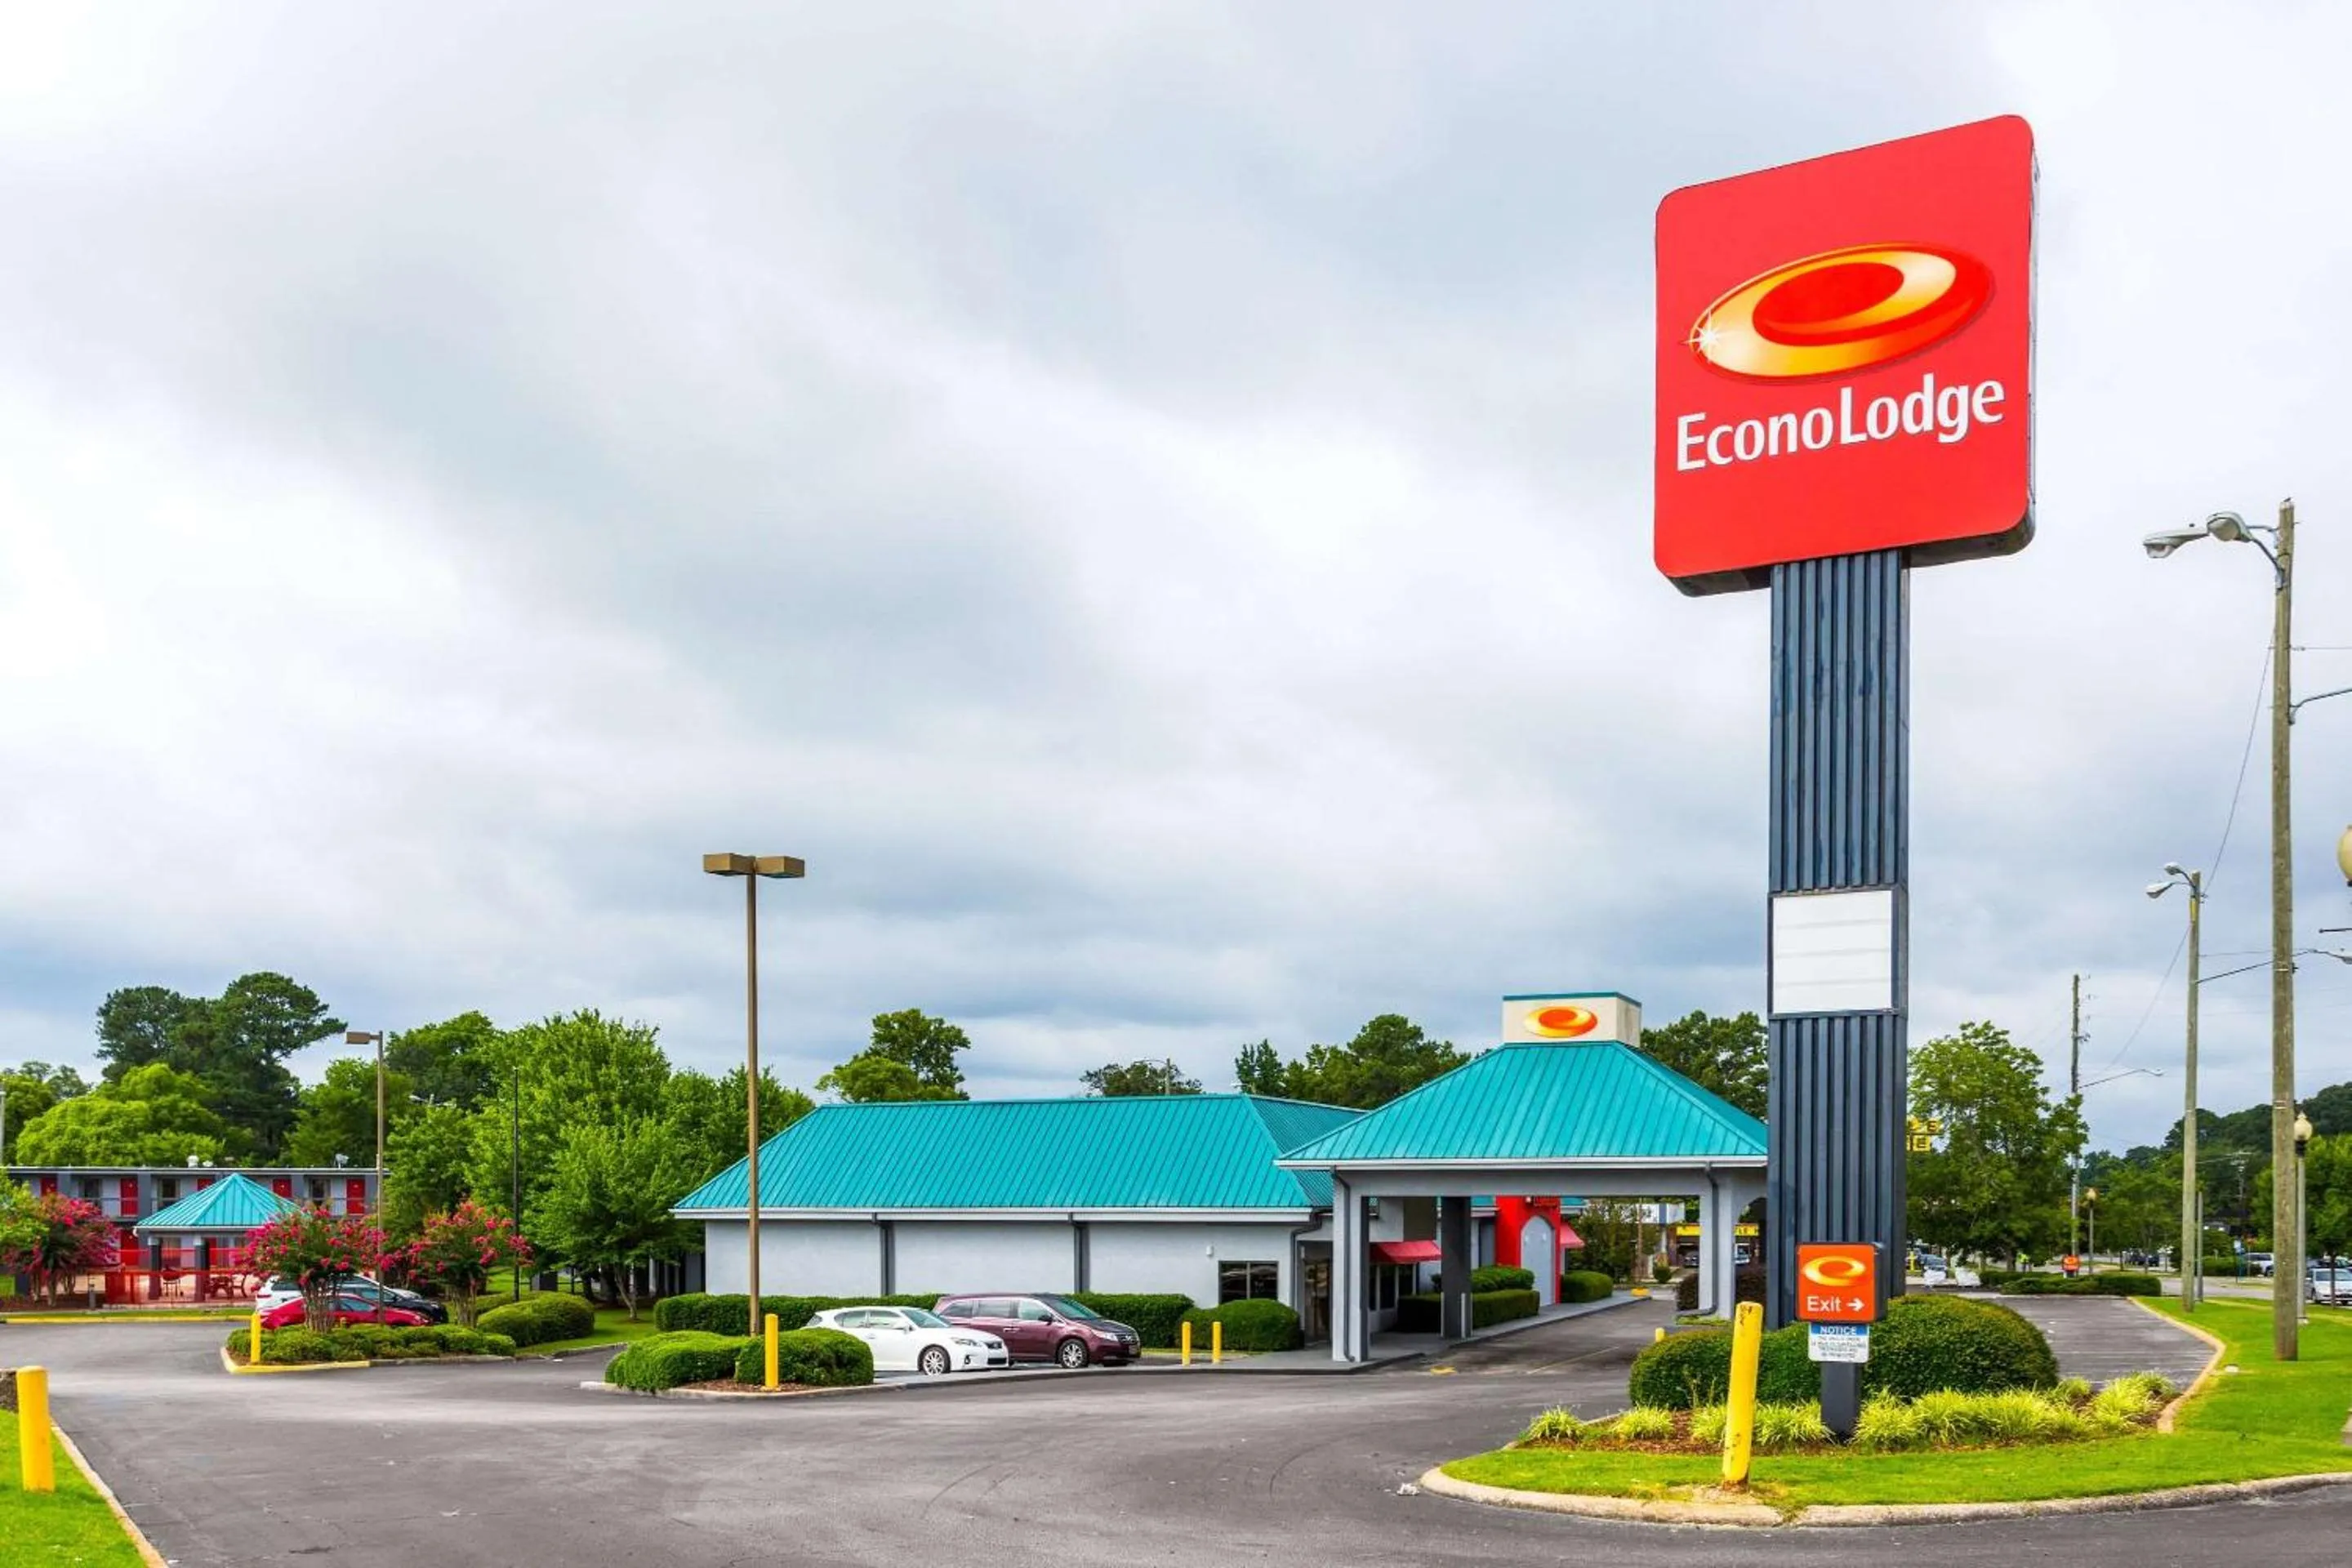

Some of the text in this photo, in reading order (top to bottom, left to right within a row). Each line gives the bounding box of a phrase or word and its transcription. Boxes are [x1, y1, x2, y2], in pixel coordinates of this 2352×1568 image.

[1677, 372, 2005, 471] EconoLodge
[1806, 1295, 1842, 1312] Exit
[1820, 1325, 1856, 1335] NOTICE
